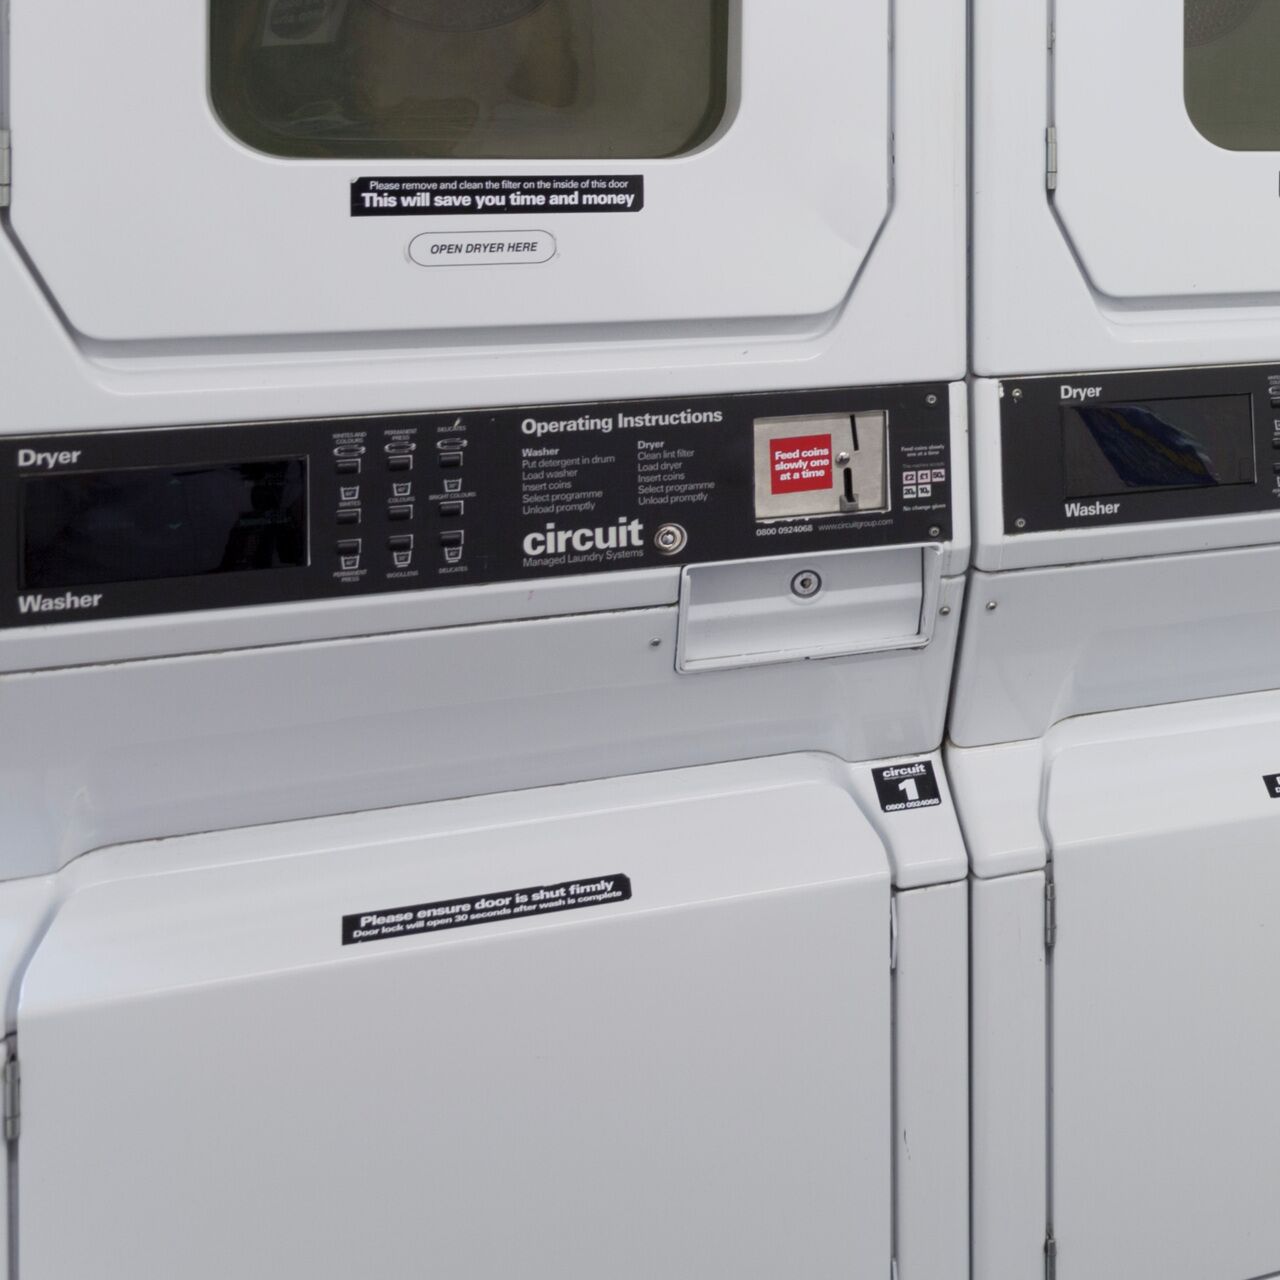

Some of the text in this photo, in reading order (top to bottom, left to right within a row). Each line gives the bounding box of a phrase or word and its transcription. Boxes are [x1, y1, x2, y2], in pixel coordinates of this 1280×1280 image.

[370, 180, 400, 190] Please
[402, 181, 438, 190] remove
[440, 180, 456, 189] and
[459, 180, 483, 189] clean
[486, 180, 499, 189] the
[501, 179, 521, 189] filter
[537, 179, 550, 188] the
[553, 179, 578, 189] inside
[580, 179, 590, 188] of
[591, 179, 606, 188] this
[608, 179, 628, 188] door
[362, 191, 634, 209] This will save you time and money
[430, 242, 538, 254] OPEN DRYER HERE
[1060, 385, 1102, 402] Dryer
[521, 409, 723, 437] Operating Instructions
[638, 440, 665, 450] Dryer
[18, 448, 81, 469] Dryer
[522, 447, 559, 457] Washer
[638, 449, 695, 460] Clean lint filter
[775, 448, 829, 459] Feed coins
[522, 454, 615, 469] Put detergent in drum
[638, 461, 683, 472] Load dryer
[775, 459, 807, 470] slowly
[522, 469, 578, 481] Load washer
[638, 472, 685, 483] Insert coins
[780, 471, 790, 480] at
[801, 469, 825, 478] time
[522, 481, 572, 491] Insert coins
[638, 481, 715, 494] Select programme
[523, 490, 603, 503] Select programme
[639, 492, 708, 505] Unload promptly
[523, 502, 595, 515] Unload promptly
[1065, 501, 1120, 517] Washer
[523, 516, 644, 556] circuit
[756, 527, 777, 536] 0800
[778, 525, 813, 534] 0924068
[523, 549, 644, 567] Managed Laundry Systems
[18, 591, 102, 613] Washer
[883, 764, 926, 777] circuit
[898, 778, 919, 800] 1
[360, 880, 614, 927] Please ensure door is shut firmly
[353, 890, 622, 938] Door lock will open 30 seconds after wash is complete
